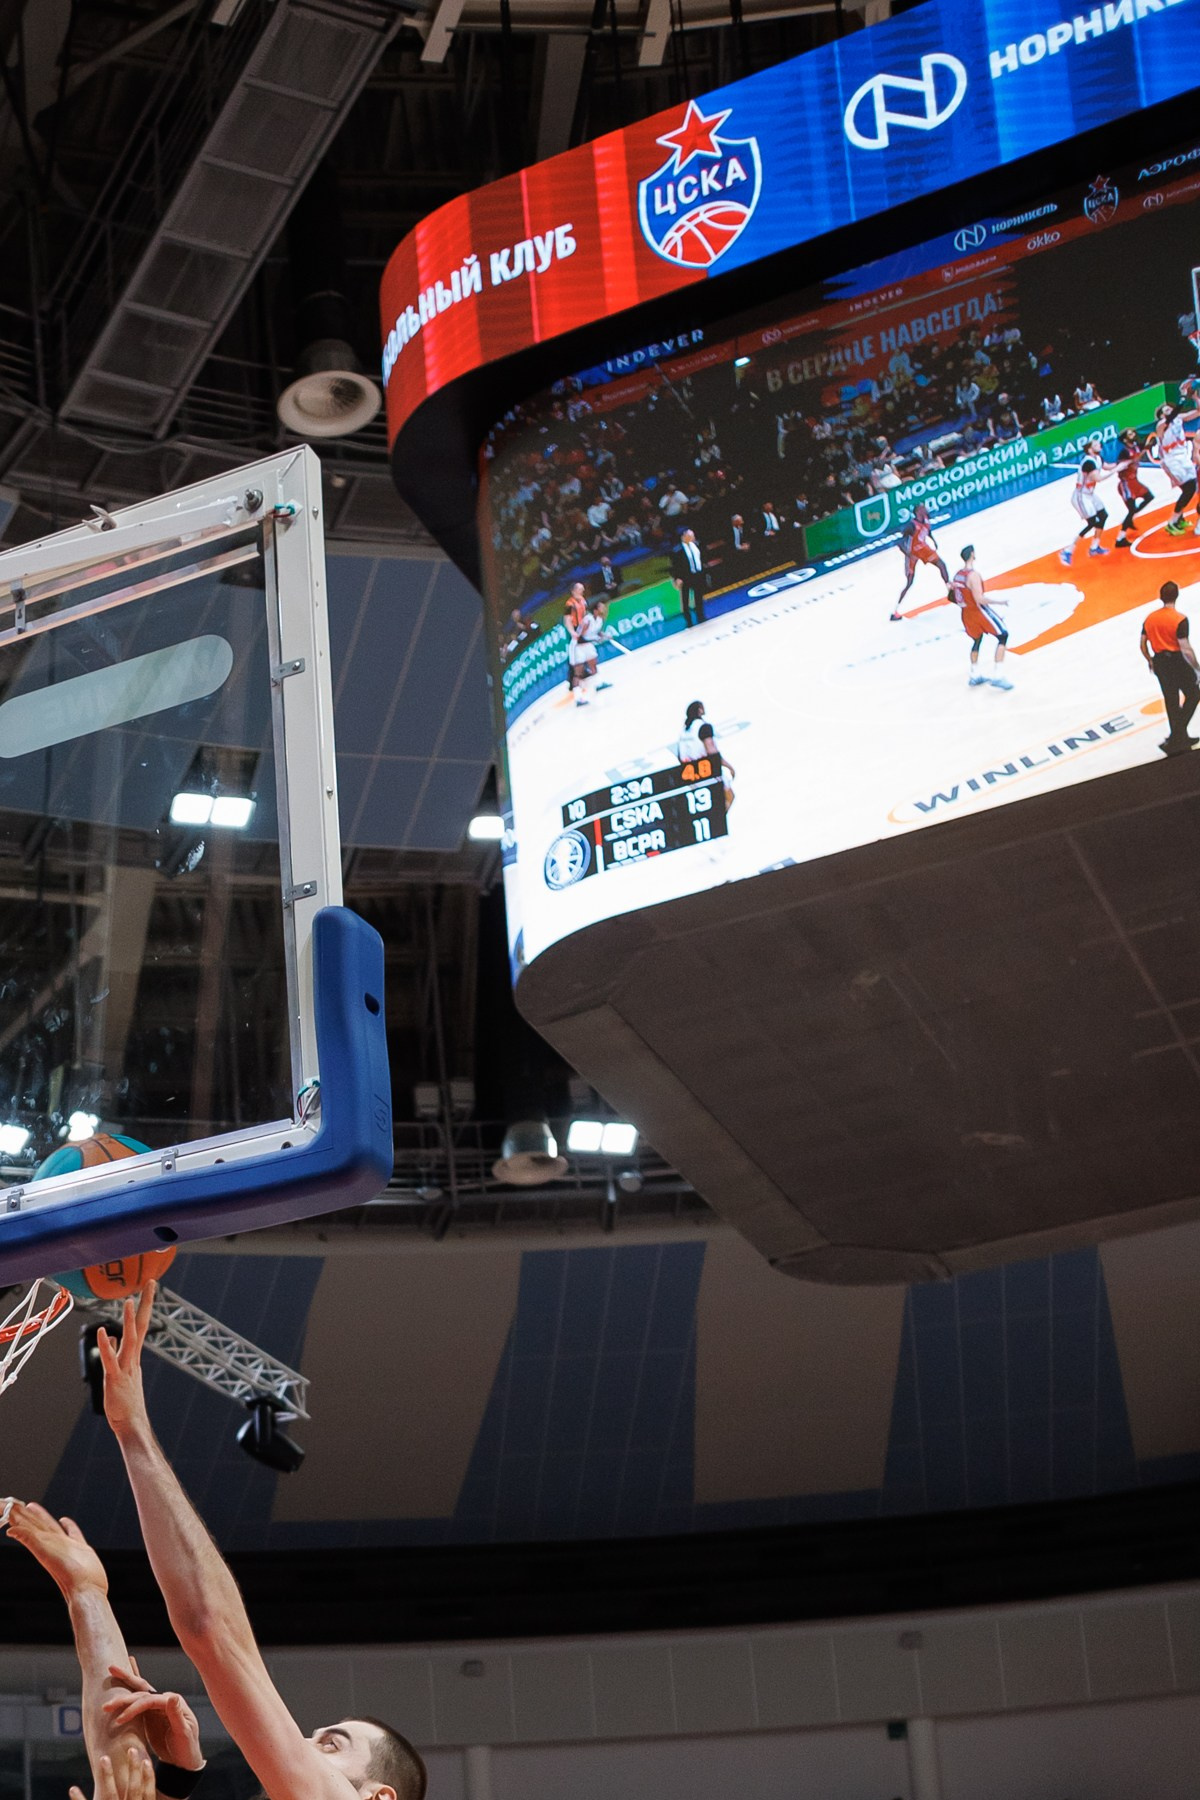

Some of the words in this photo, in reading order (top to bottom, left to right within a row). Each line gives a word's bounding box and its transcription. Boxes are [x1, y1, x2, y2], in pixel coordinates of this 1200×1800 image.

[653, 156, 749, 217] ЦСКА
[991, 202, 1058, 234] НОРНИКЕЛЬ
[490, 223, 578, 287] КЛУБ
[606, 329, 705, 374] INDEVER
[894, 437, 1030, 504] МОСКОВСКИЙ
[603, 605, 665, 638] АВОД
[913, 714, 1135, 813] WINLINE
[610, 801, 664, 833] CSKA
[685, 787, 713, 814] 19
[692, 817, 711, 842] 11
